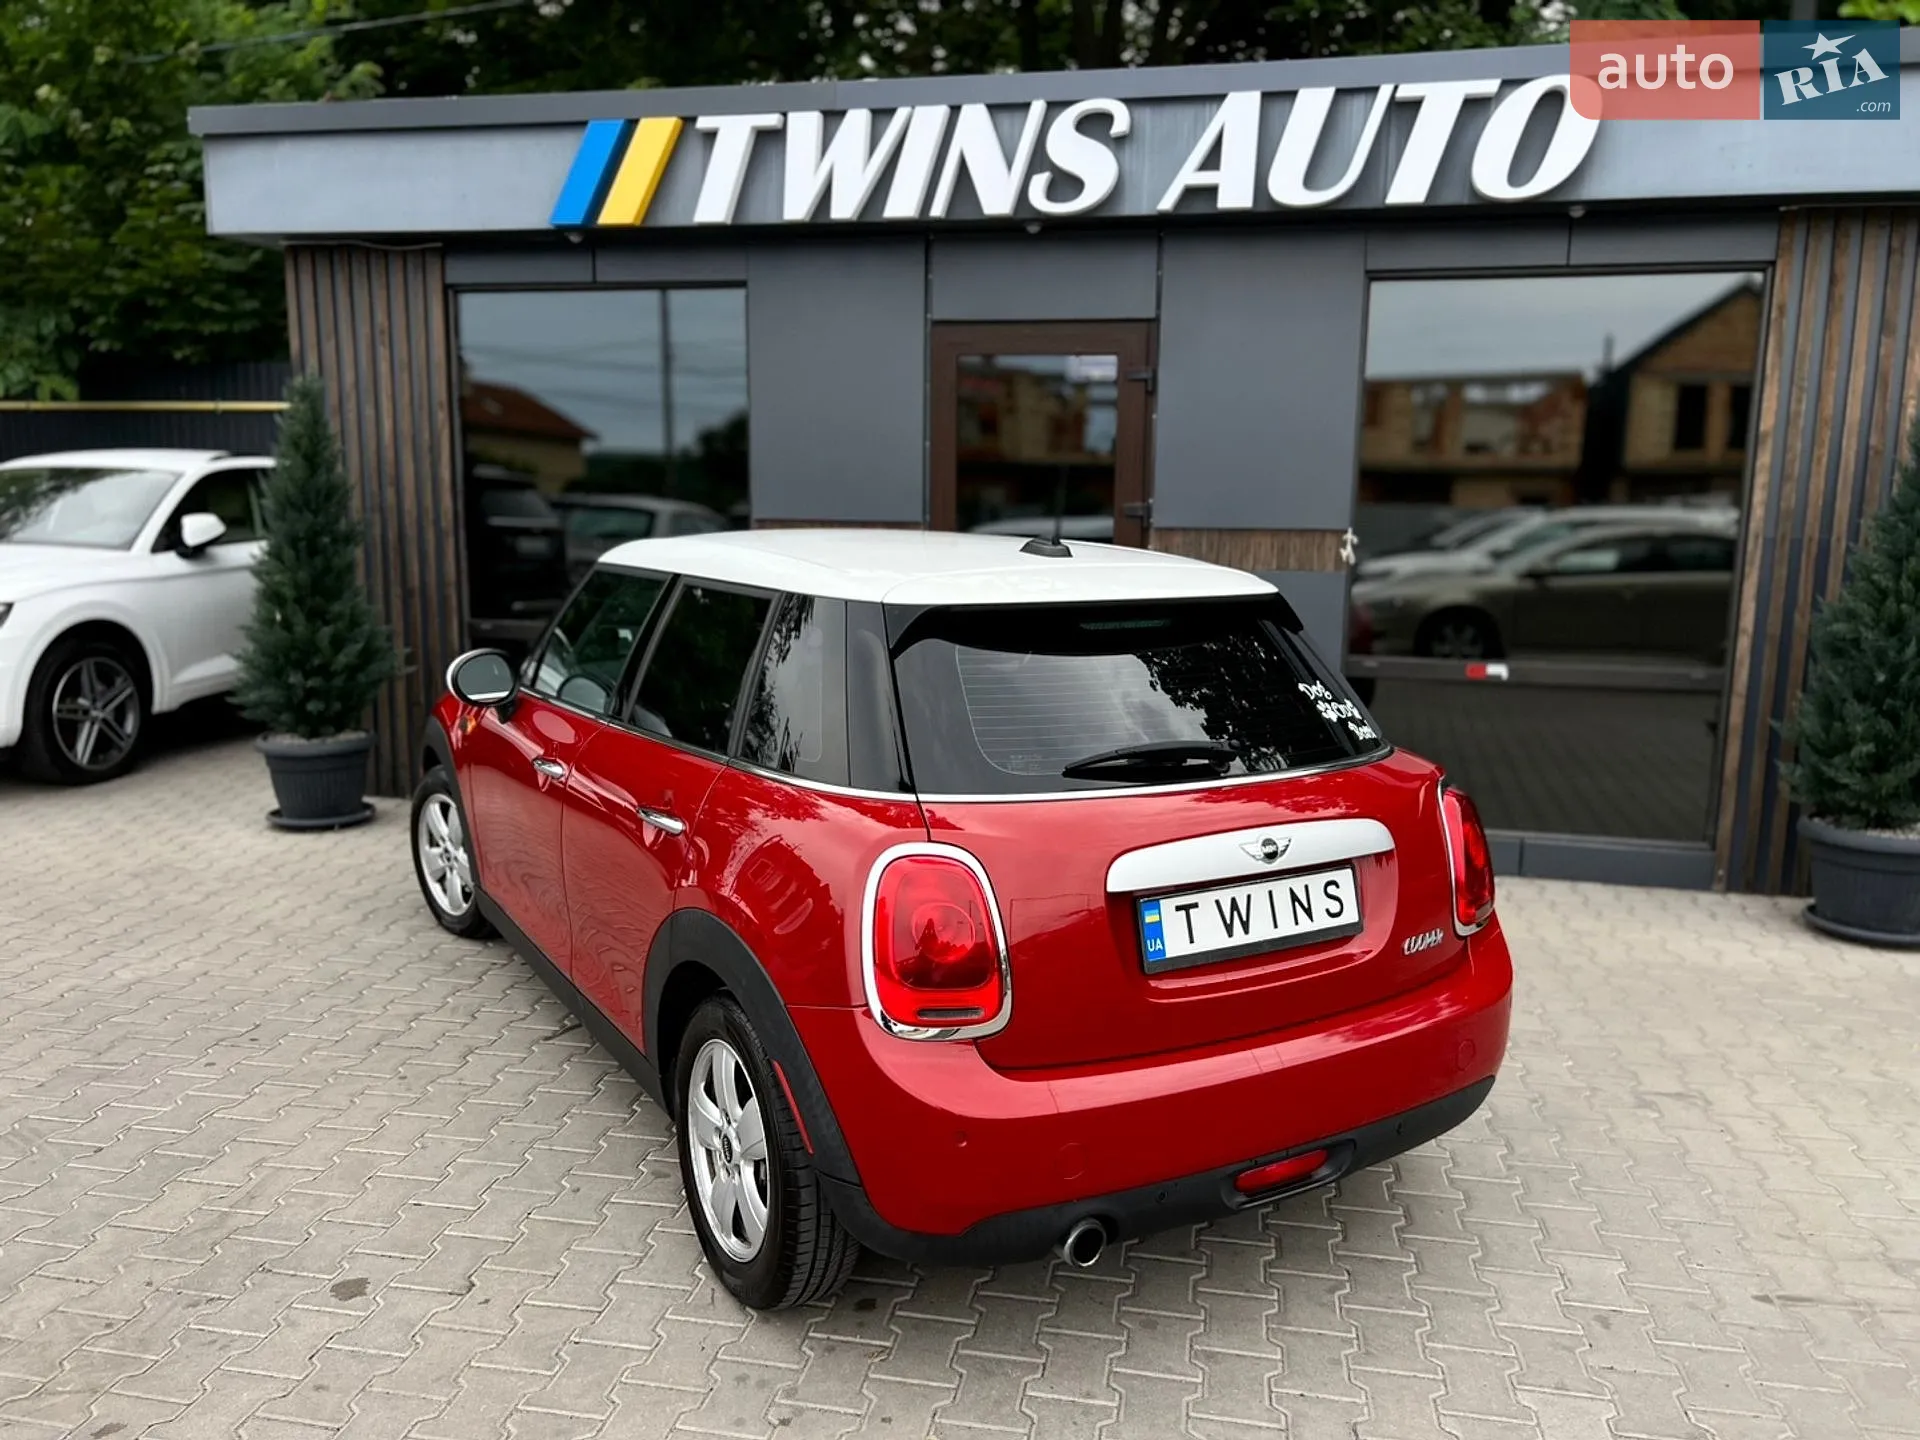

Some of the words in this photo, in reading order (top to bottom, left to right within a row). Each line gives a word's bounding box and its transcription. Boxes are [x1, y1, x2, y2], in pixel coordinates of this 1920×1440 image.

[693, 97, 1132, 225] TWINS
[1156, 74, 1603, 213] AUTO
[1174, 879, 1345, 944] TWINS
[1146, 938, 1163, 952] UA
